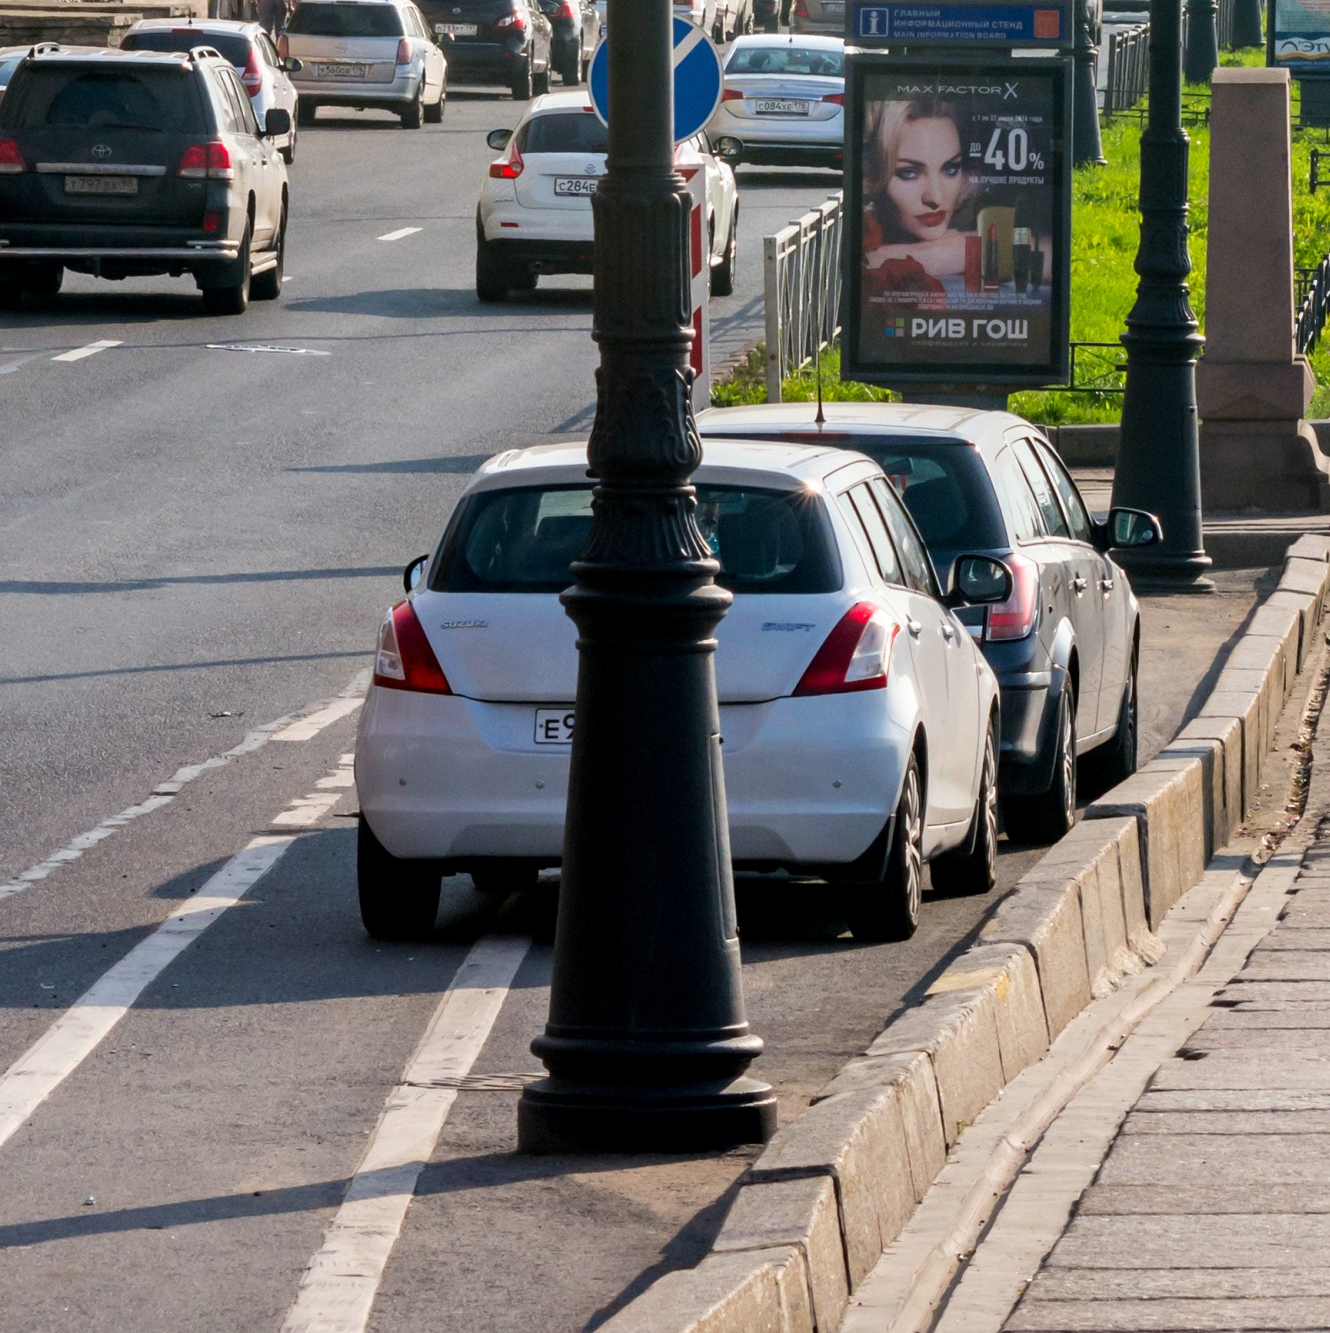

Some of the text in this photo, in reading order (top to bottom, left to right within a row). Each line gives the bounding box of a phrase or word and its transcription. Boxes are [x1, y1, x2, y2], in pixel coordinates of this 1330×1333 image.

[893, 8, 941, 18] ГЛАВНЫЙ
[893, 19, 1023, 30] ИНФОРМАЦИОННЫЙ СТЕНД
[896, 85, 934, 94] MAX
[937, 85, 1002, 95] FACTOR
[558, 180, 597, 193] С284Е
[911, 318, 1028, 339] РИВ ГОШ
[544, 713, 576, 740] Е9
